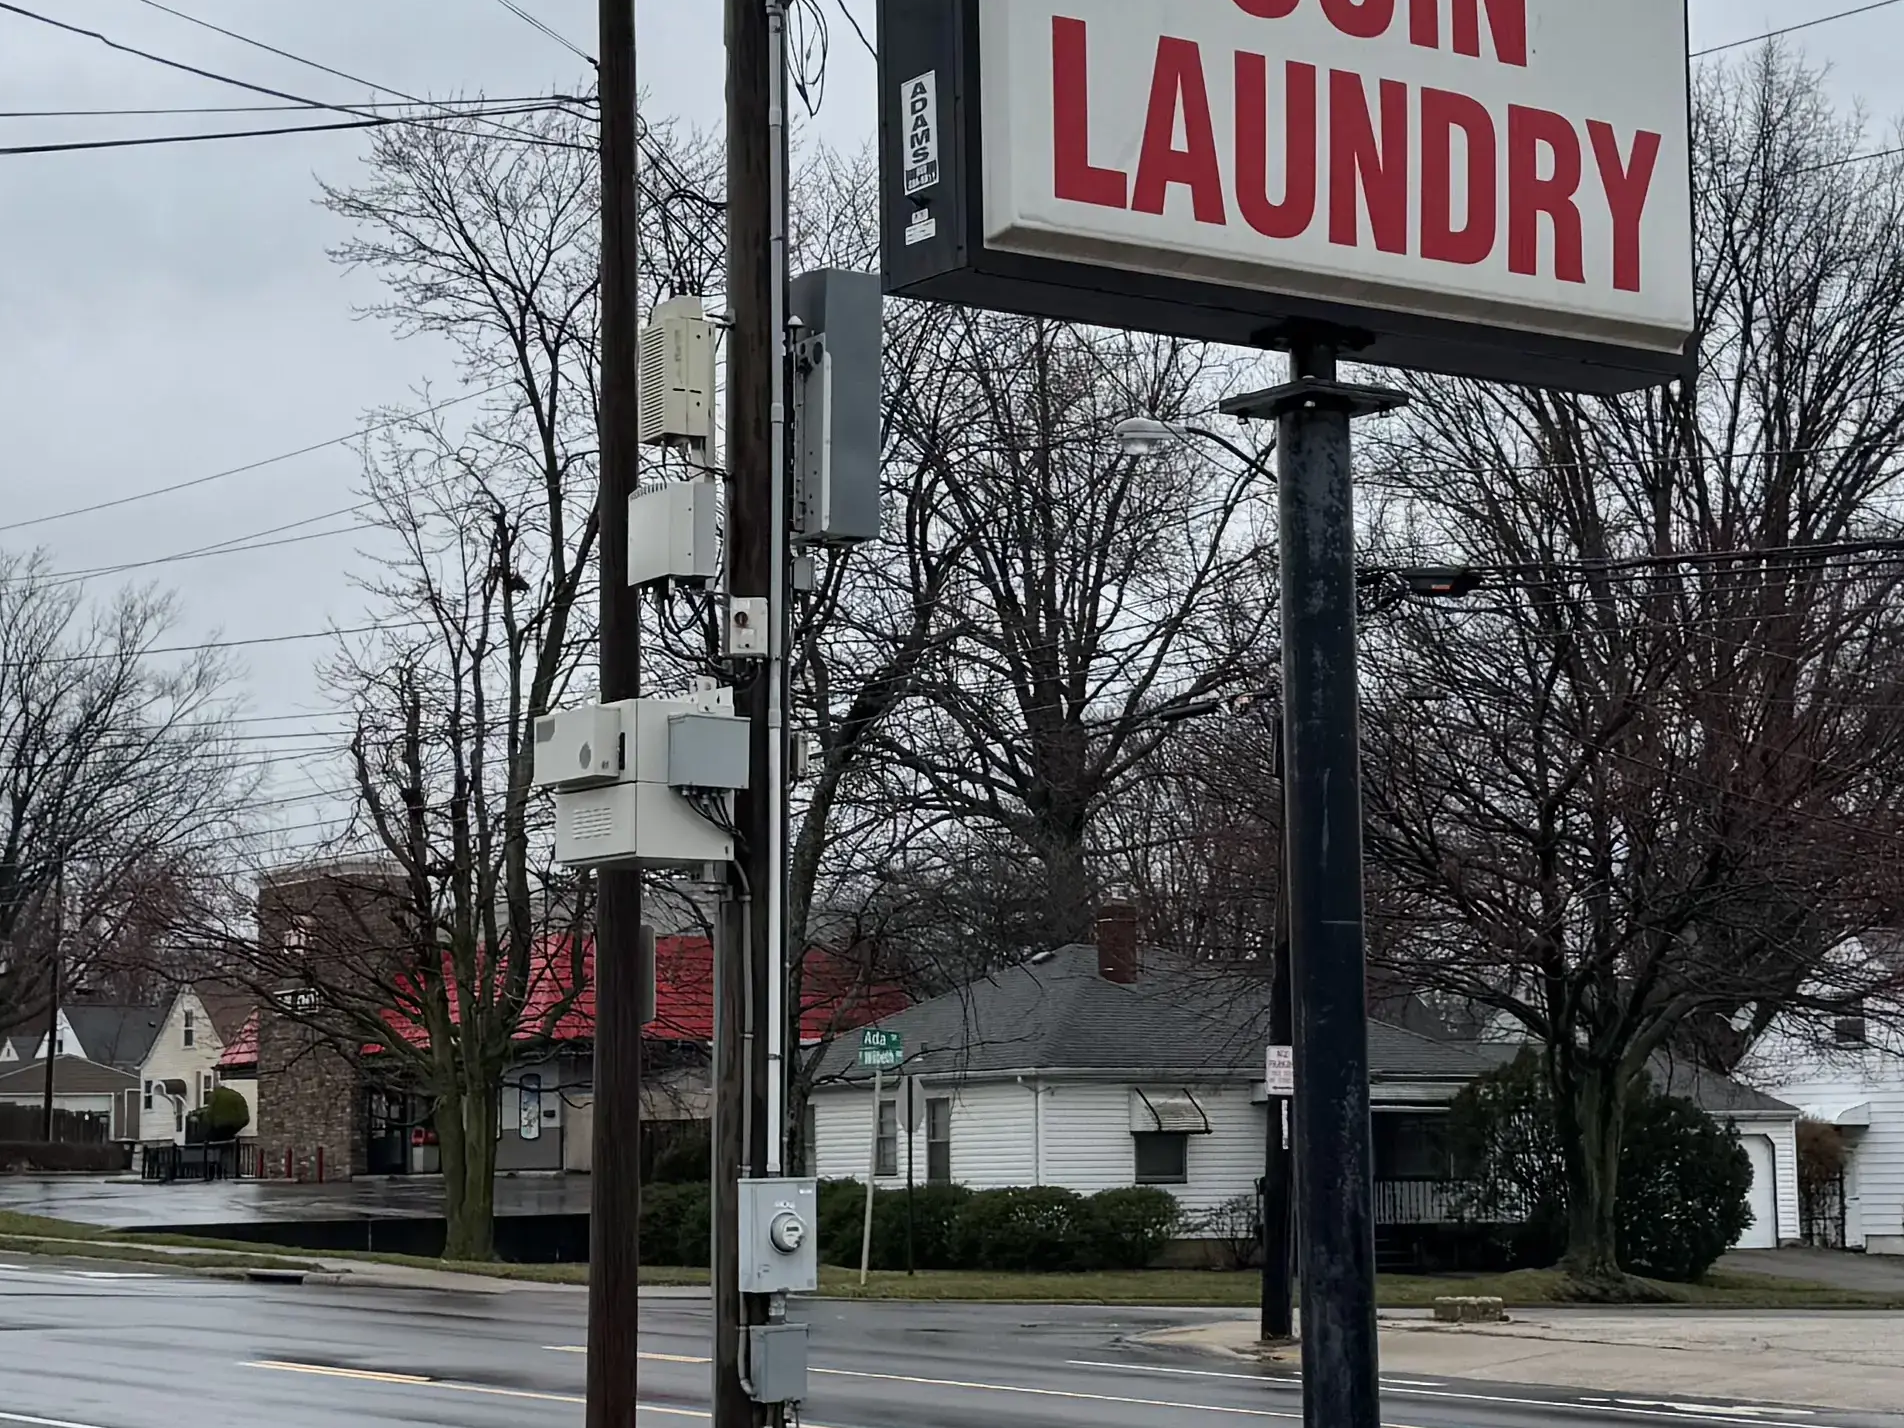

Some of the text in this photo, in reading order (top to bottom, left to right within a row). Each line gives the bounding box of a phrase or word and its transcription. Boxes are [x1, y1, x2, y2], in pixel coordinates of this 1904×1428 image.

[909, 81, 930, 164] ADAMS
[1051, 15, 1662, 294] LAUNDRY
[864, 1031, 887, 1046] Ada
